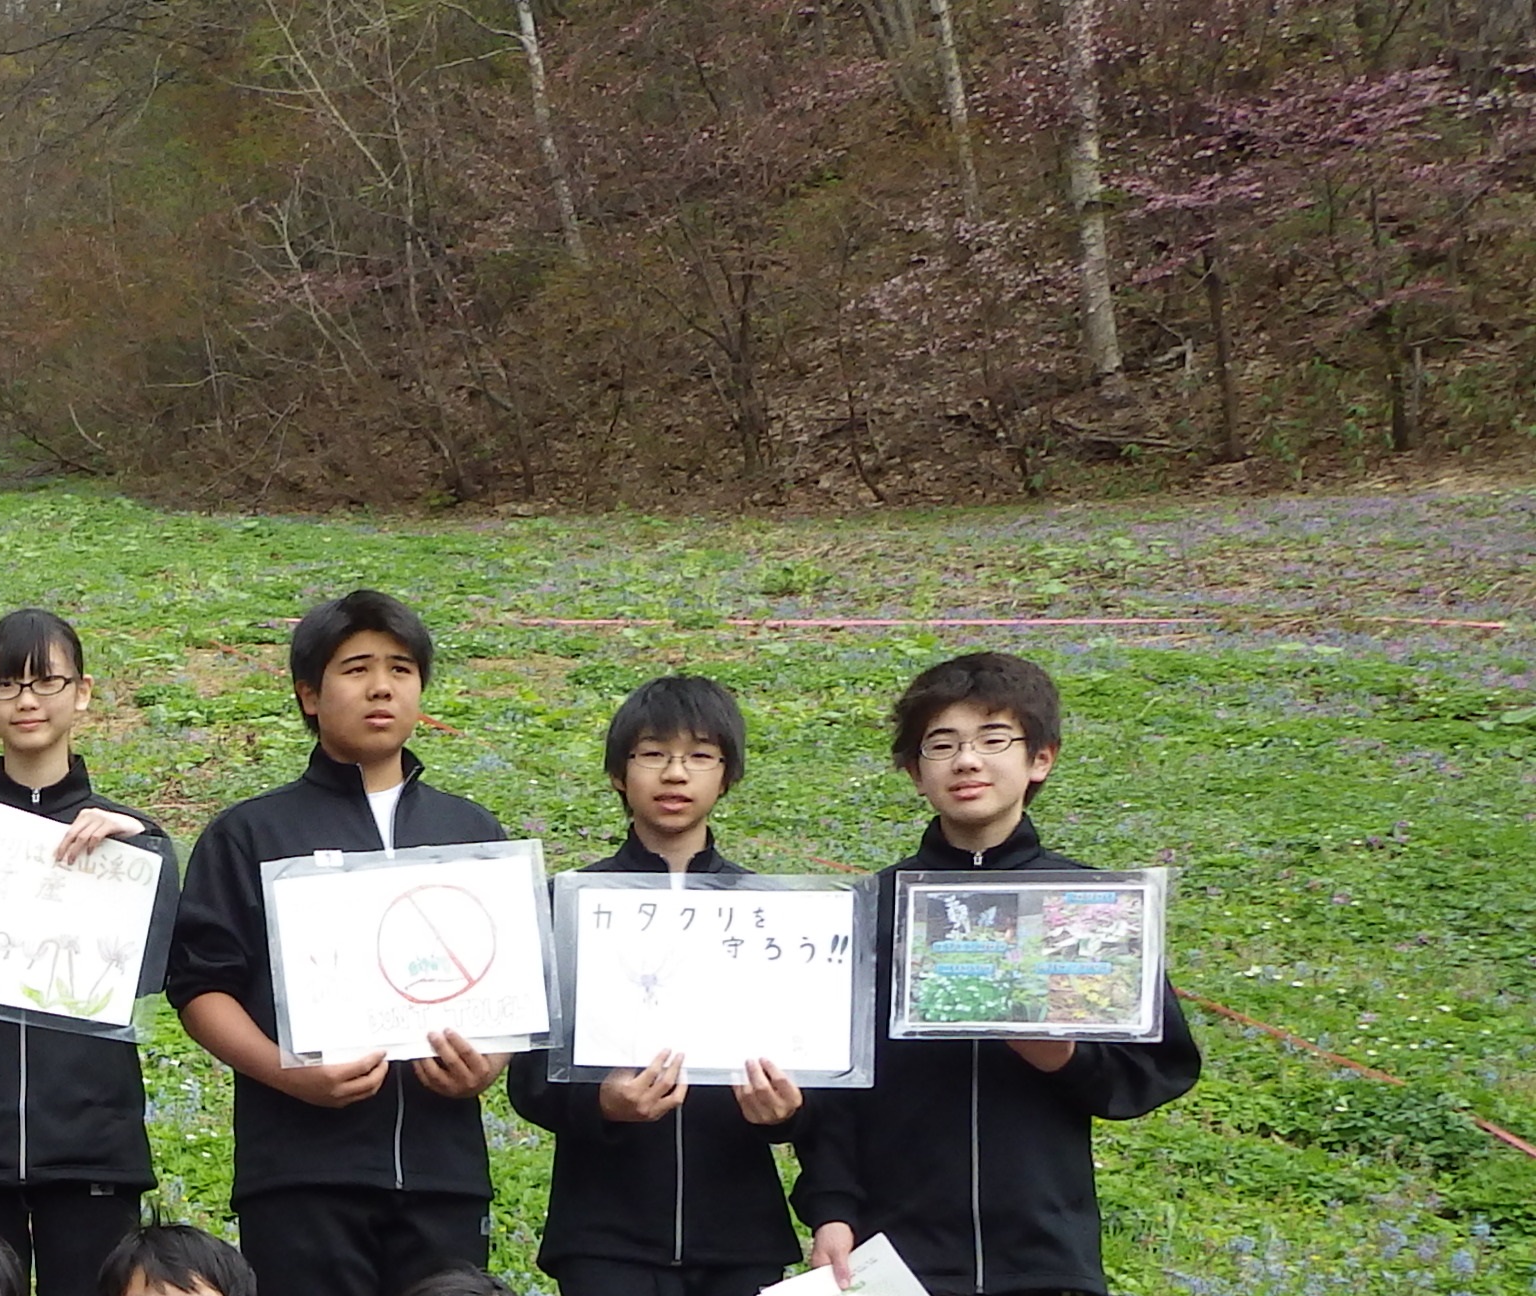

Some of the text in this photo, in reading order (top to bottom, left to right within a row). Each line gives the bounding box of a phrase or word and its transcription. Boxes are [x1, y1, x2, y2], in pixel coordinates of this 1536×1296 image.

[592, 902, 766, 932] カタクリを
